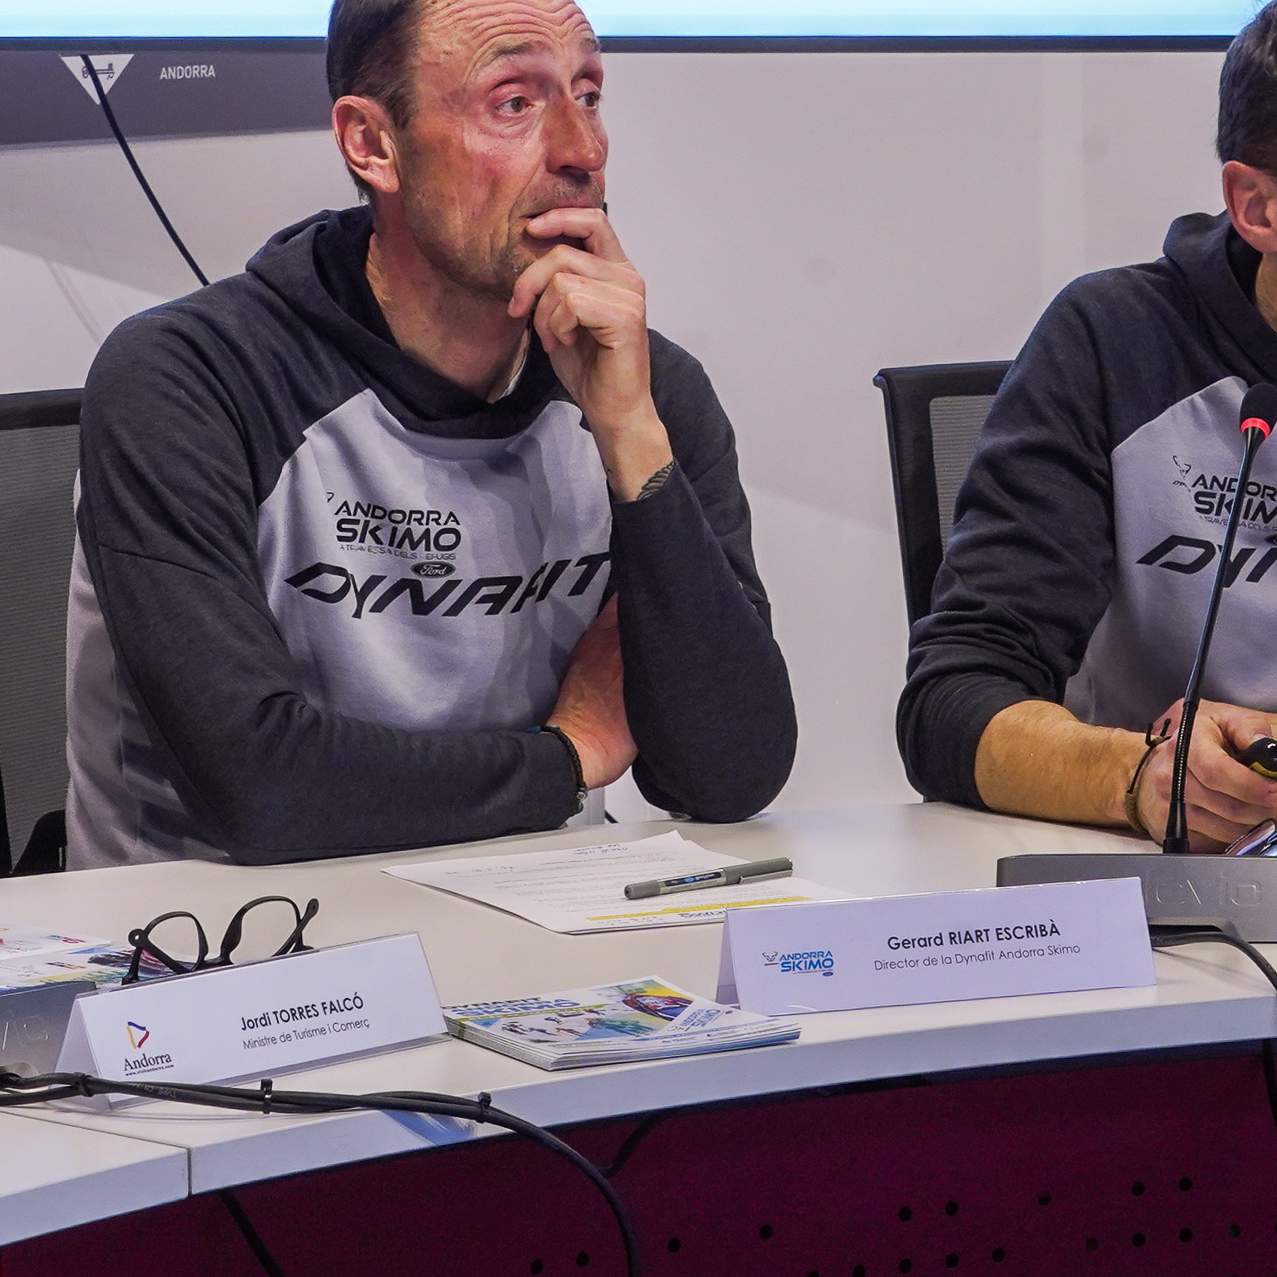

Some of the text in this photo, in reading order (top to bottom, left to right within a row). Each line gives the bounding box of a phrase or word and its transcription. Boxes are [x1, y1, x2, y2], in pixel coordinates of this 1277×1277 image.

[160, 65, 215, 79] ANDORRA
[334, 500, 460, 526] ANDORRA
[336, 518, 461, 552] SKIMO
[888, 919, 1060, 950] Gerard RIART ESCRIBÀ
[874, 942, 1080, 970] Director Dynafit Andorra Skimo
[242, 992, 363, 1031] Jordi TORRES FALCÓ
[243, 1019, 370, 1049] Ministre Turisme Comerç
[124, 1053, 172, 1071] Andorra
